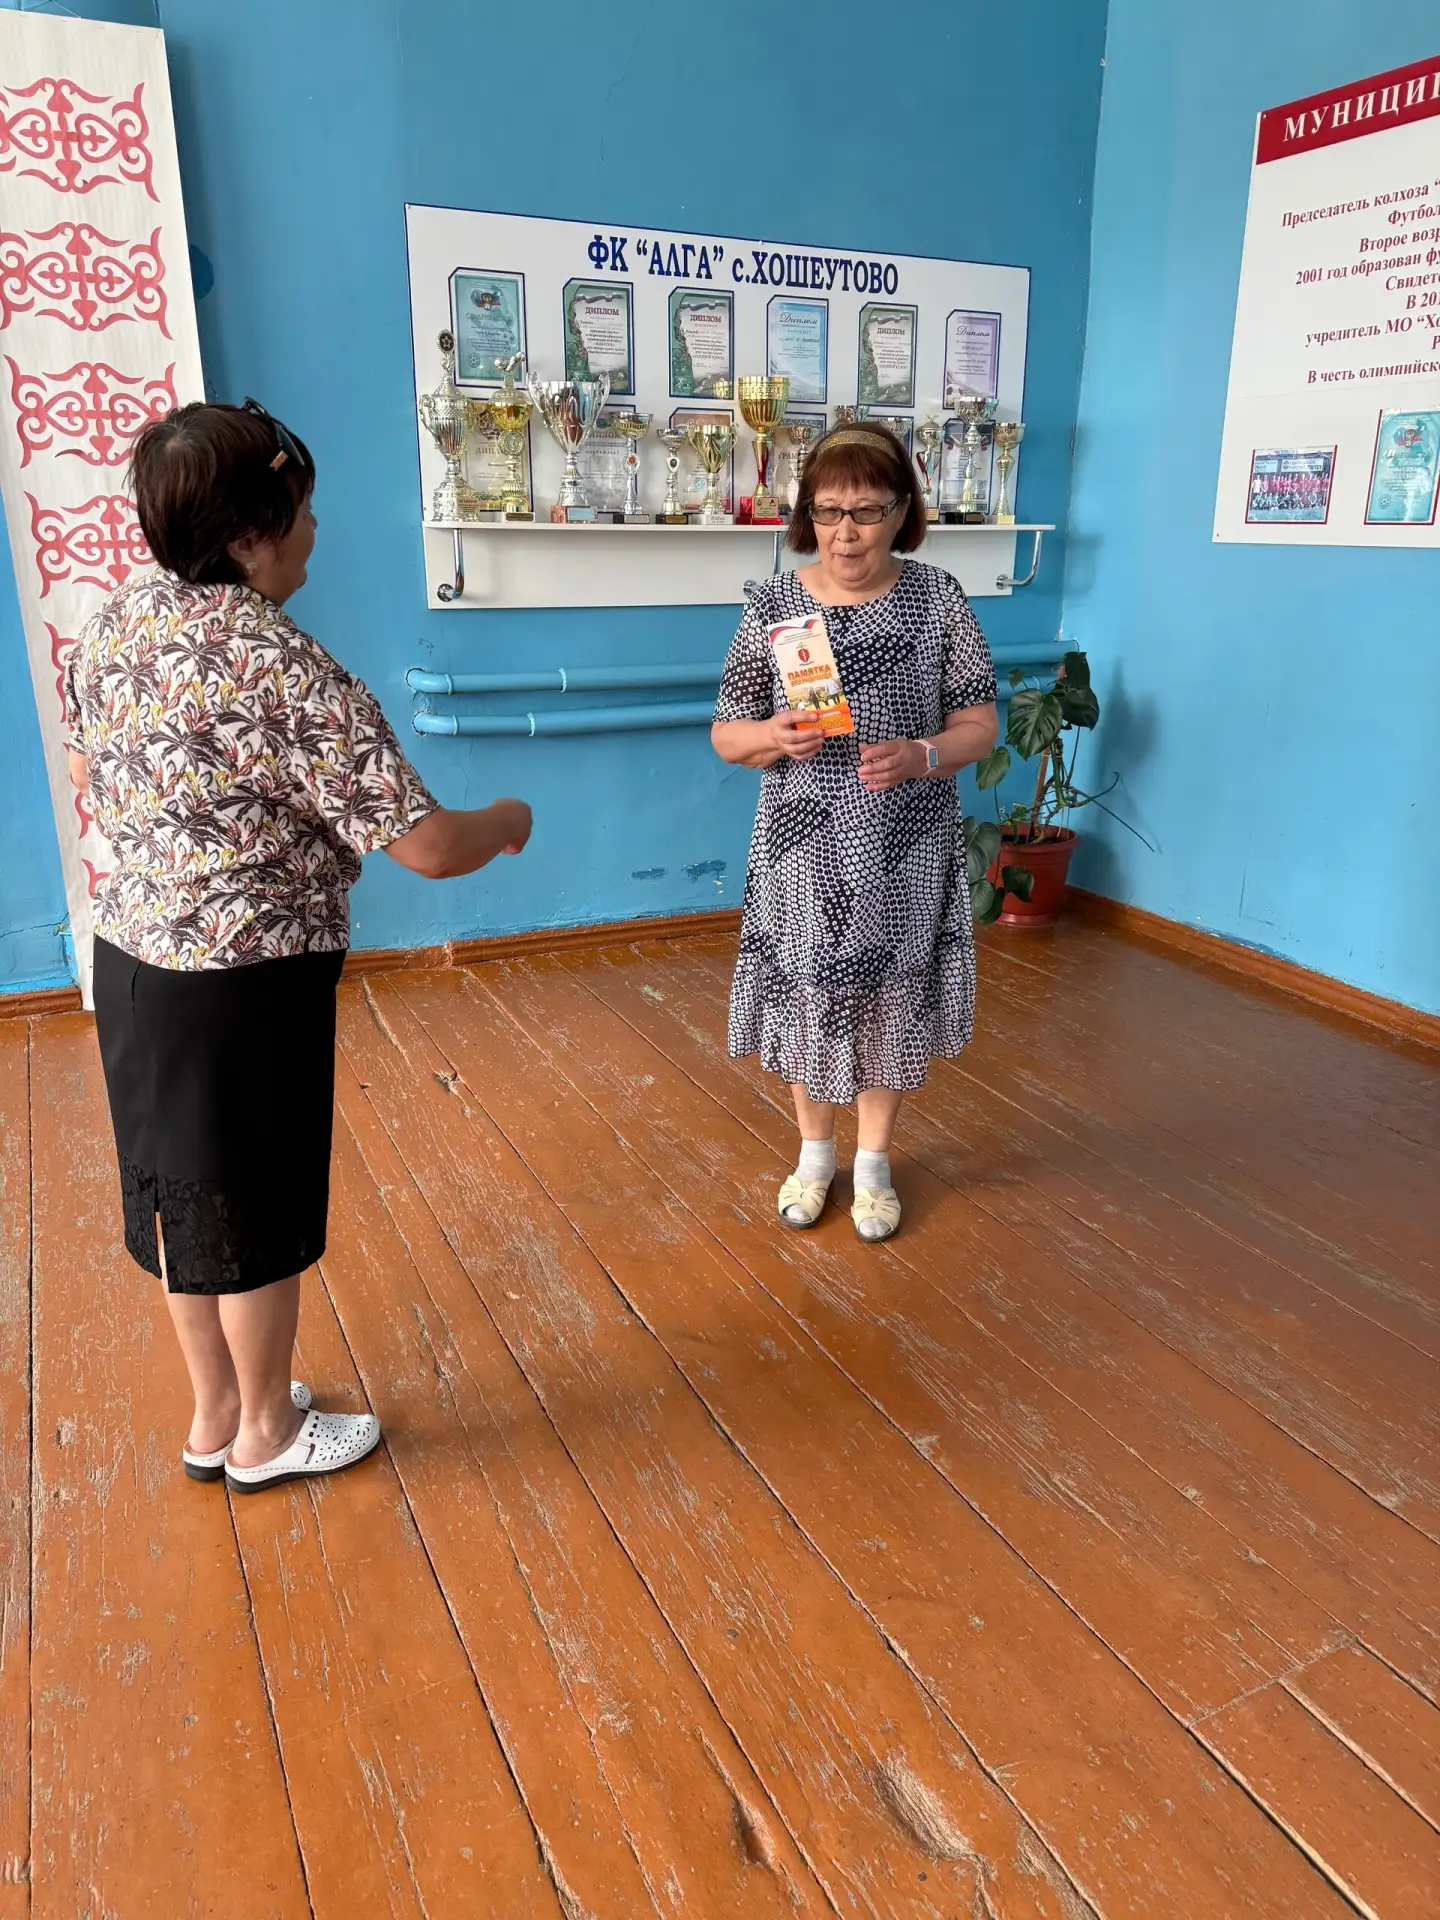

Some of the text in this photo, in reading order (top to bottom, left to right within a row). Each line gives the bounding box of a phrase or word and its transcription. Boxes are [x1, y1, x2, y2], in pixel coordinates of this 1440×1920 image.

[1282, 184, 1429, 228] Председатель колхоза
[1359, 232, 1408, 253] Второе
[587, 235, 629, 272] ФК
[732, 250, 899, 295] с.ХОШЕУТОВО
[1295, 267, 1323, 285] 2001
[1327, 266, 1347, 280] год
[1351, 253, 1421, 276] образован
[1385, 272, 1440, 291] Свидет
[1405, 294, 1417, 309] В
[585, 306, 620, 316] ДИПЛОМ
[690, 314, 722, 323] ДИПЛОМ
[779, 311, 818, 325] Диплом
[877, 327, 906, 336] ДИПЛОМ
[956, 325, 991, 337] Диплом
[1305, 324, 1381, 347] учредитель
[1385, 317, 1413, 334] МО
[1307, 359, 1440, 384] В честь олимпийск
[787, 664, 832, 680] ПАМЯТКА
